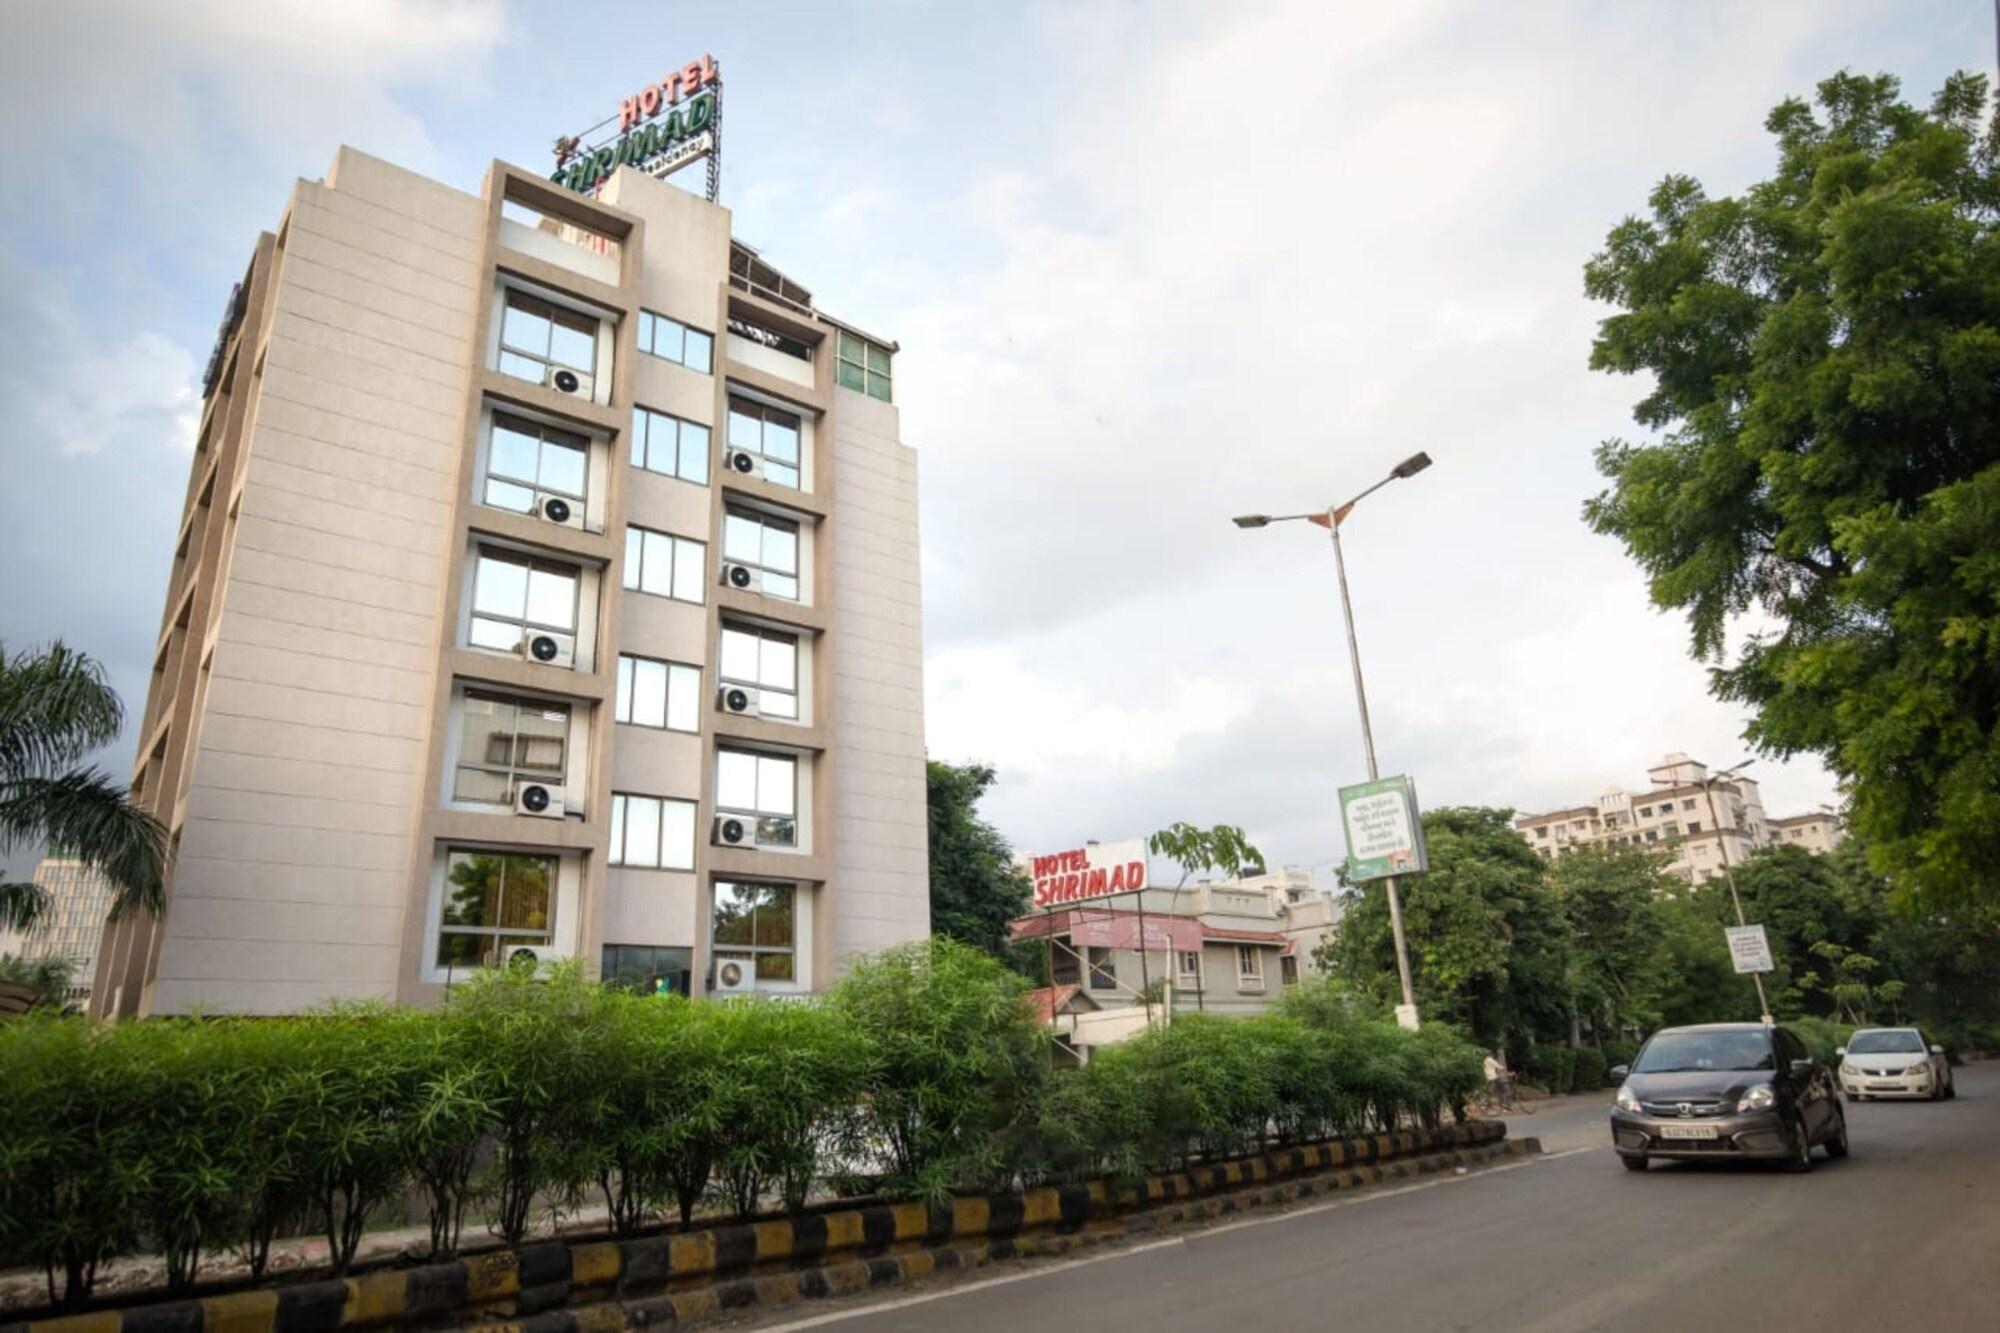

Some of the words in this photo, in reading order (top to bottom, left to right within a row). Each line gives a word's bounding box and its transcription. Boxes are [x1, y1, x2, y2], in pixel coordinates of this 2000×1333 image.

[618, 53, 719, 134] HOTEL
[1034, 848, 1090, 879] HOTEL
[1035, 861, 1144, 906] SHRIMAD
